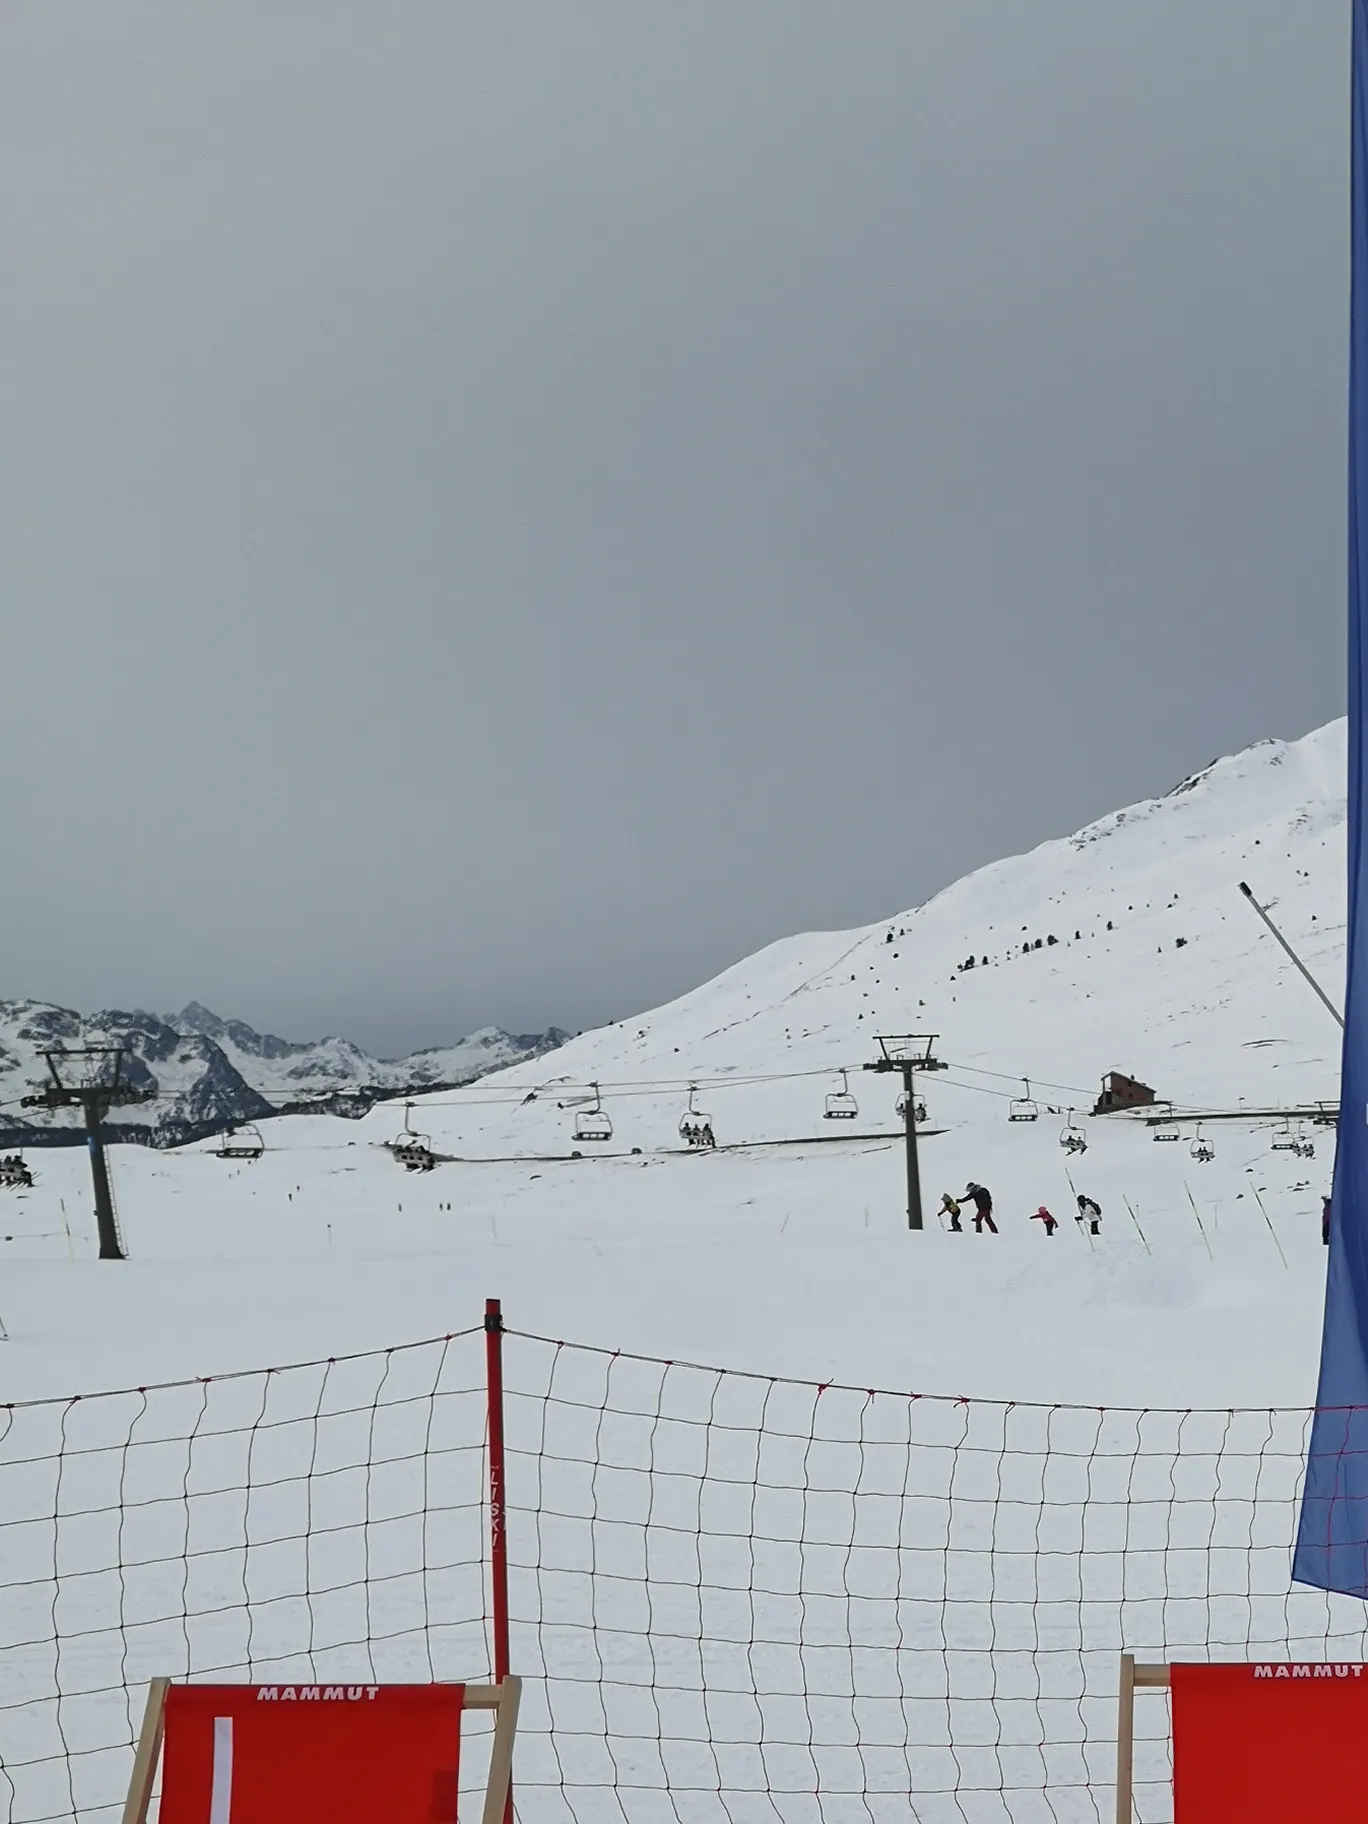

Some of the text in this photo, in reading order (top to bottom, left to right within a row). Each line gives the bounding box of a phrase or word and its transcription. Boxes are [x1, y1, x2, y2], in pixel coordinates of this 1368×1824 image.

[490, 1471, 501, 1547] LISKI
[1253, 1664, 1364, 1679] MAMMUT
[257, 1686, 380, 1701] MAMMUT
